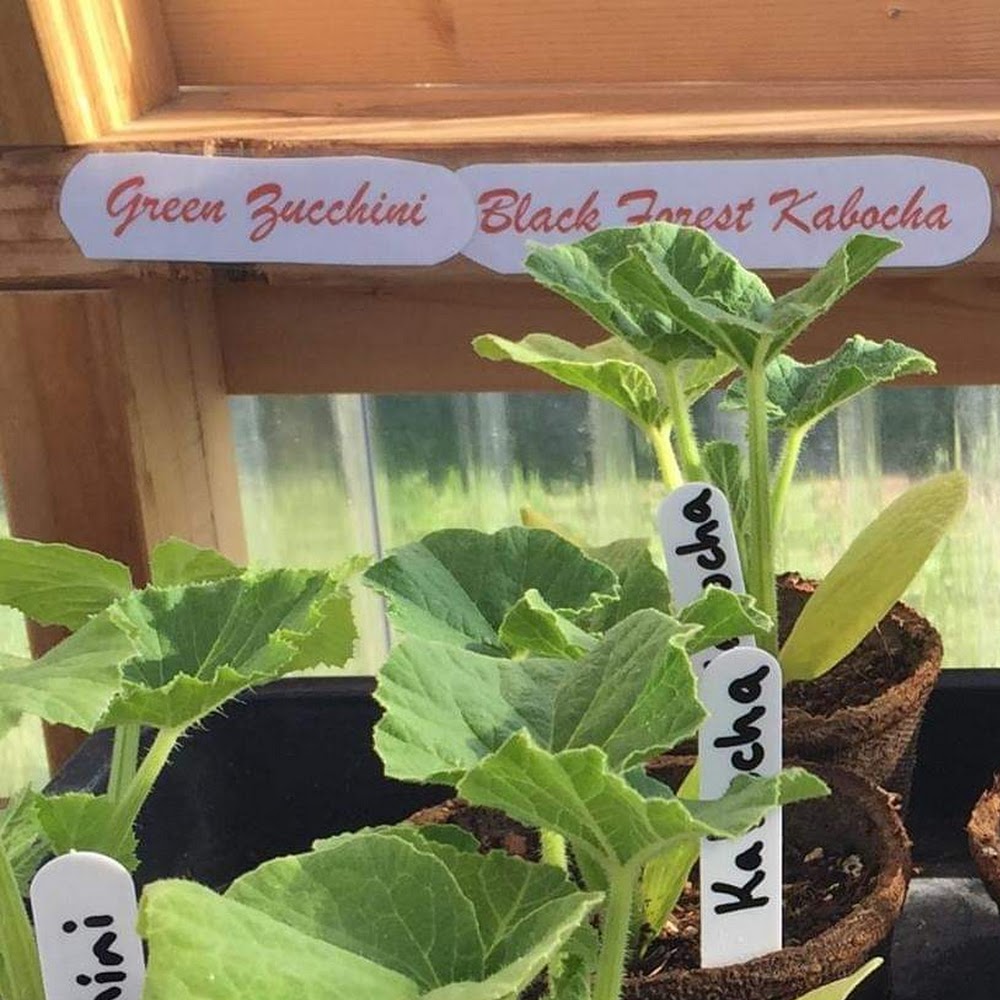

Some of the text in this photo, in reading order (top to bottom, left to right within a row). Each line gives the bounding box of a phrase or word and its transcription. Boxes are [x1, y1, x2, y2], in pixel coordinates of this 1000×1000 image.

[106, 176, 427, 243] Green Zucchini
[478, 186, 953, 234] Black Forest Kabocha
[706, 665, 770, 915] Kacha
